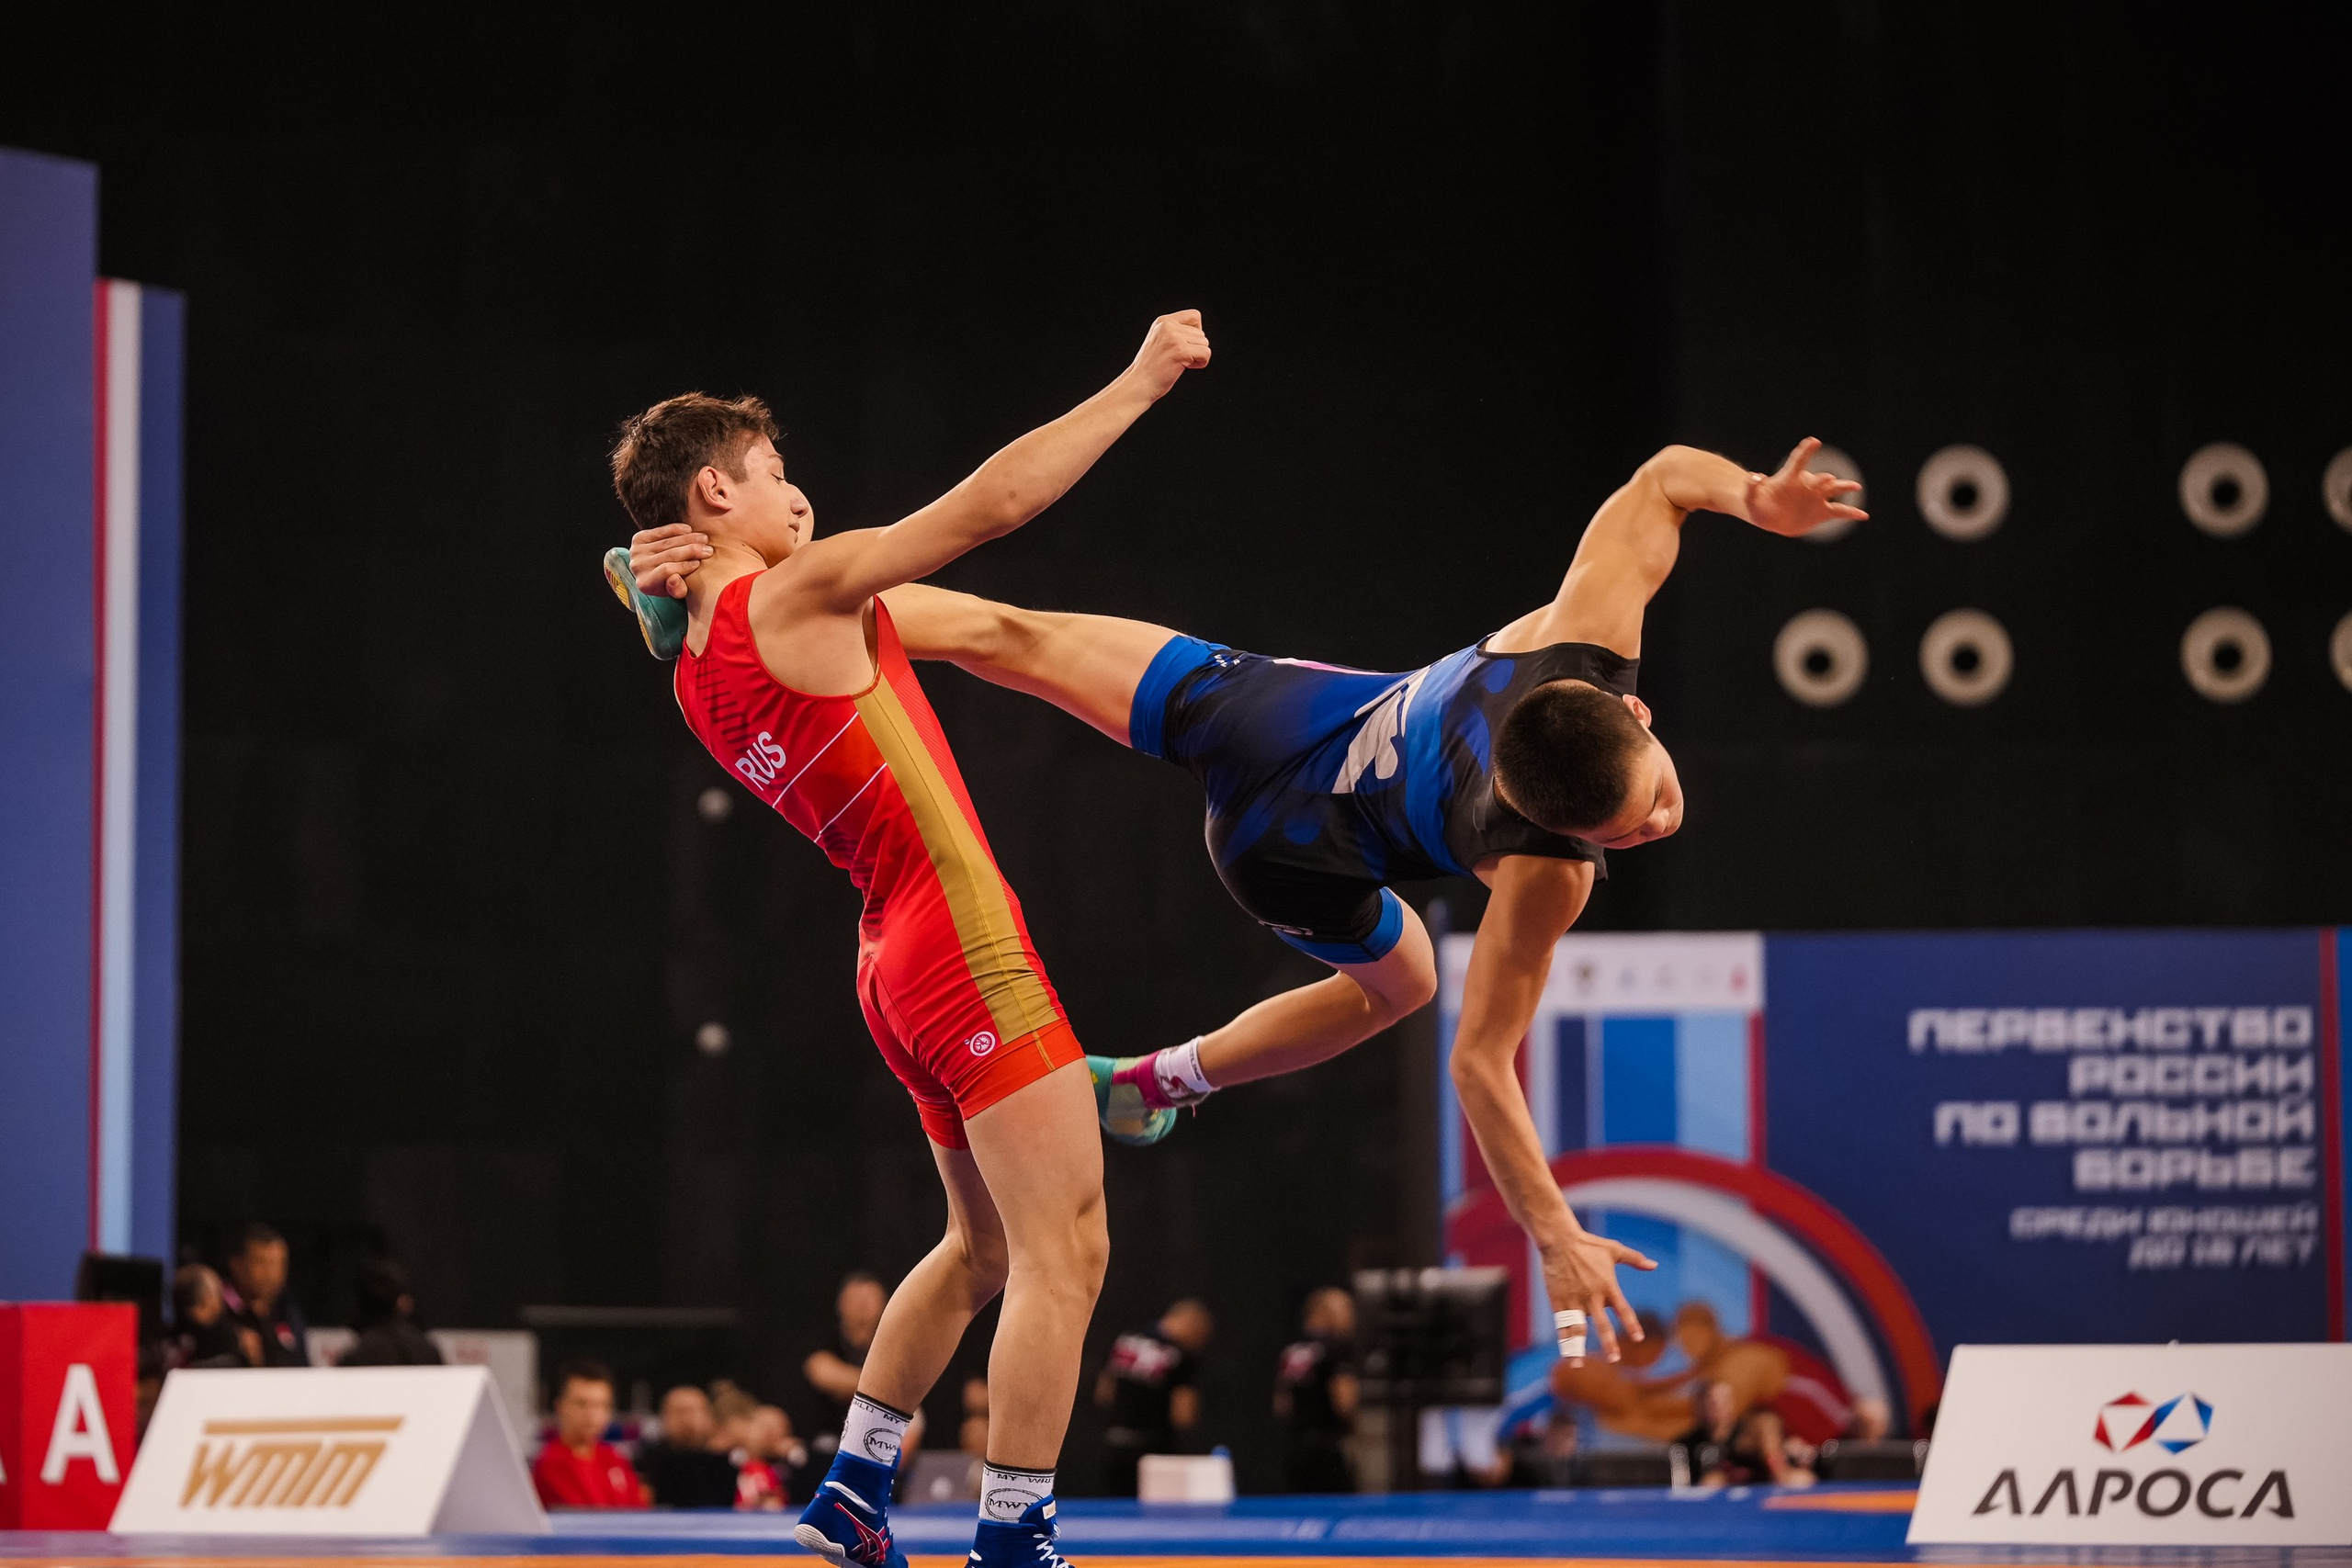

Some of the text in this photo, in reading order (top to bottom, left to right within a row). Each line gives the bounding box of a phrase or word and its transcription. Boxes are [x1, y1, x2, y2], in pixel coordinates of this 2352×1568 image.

[735, 731, 786, 791] RUS
[1907, 1007, 2312, 1054] ПЕРВЕНСТВО
[2069, 1055, 2314, 1097] РОССИИ
[1934, 1094, 2314, 1147] ПО ВОЛЬНОЙ
[2074, 1147, 2317, 1191] БОРЬБЕ
[40, 1363, 121, 1485] A
[997, 1473, 1018, 1482] MY
[1972, 1468, 2295, 1520] АЛРОСА
